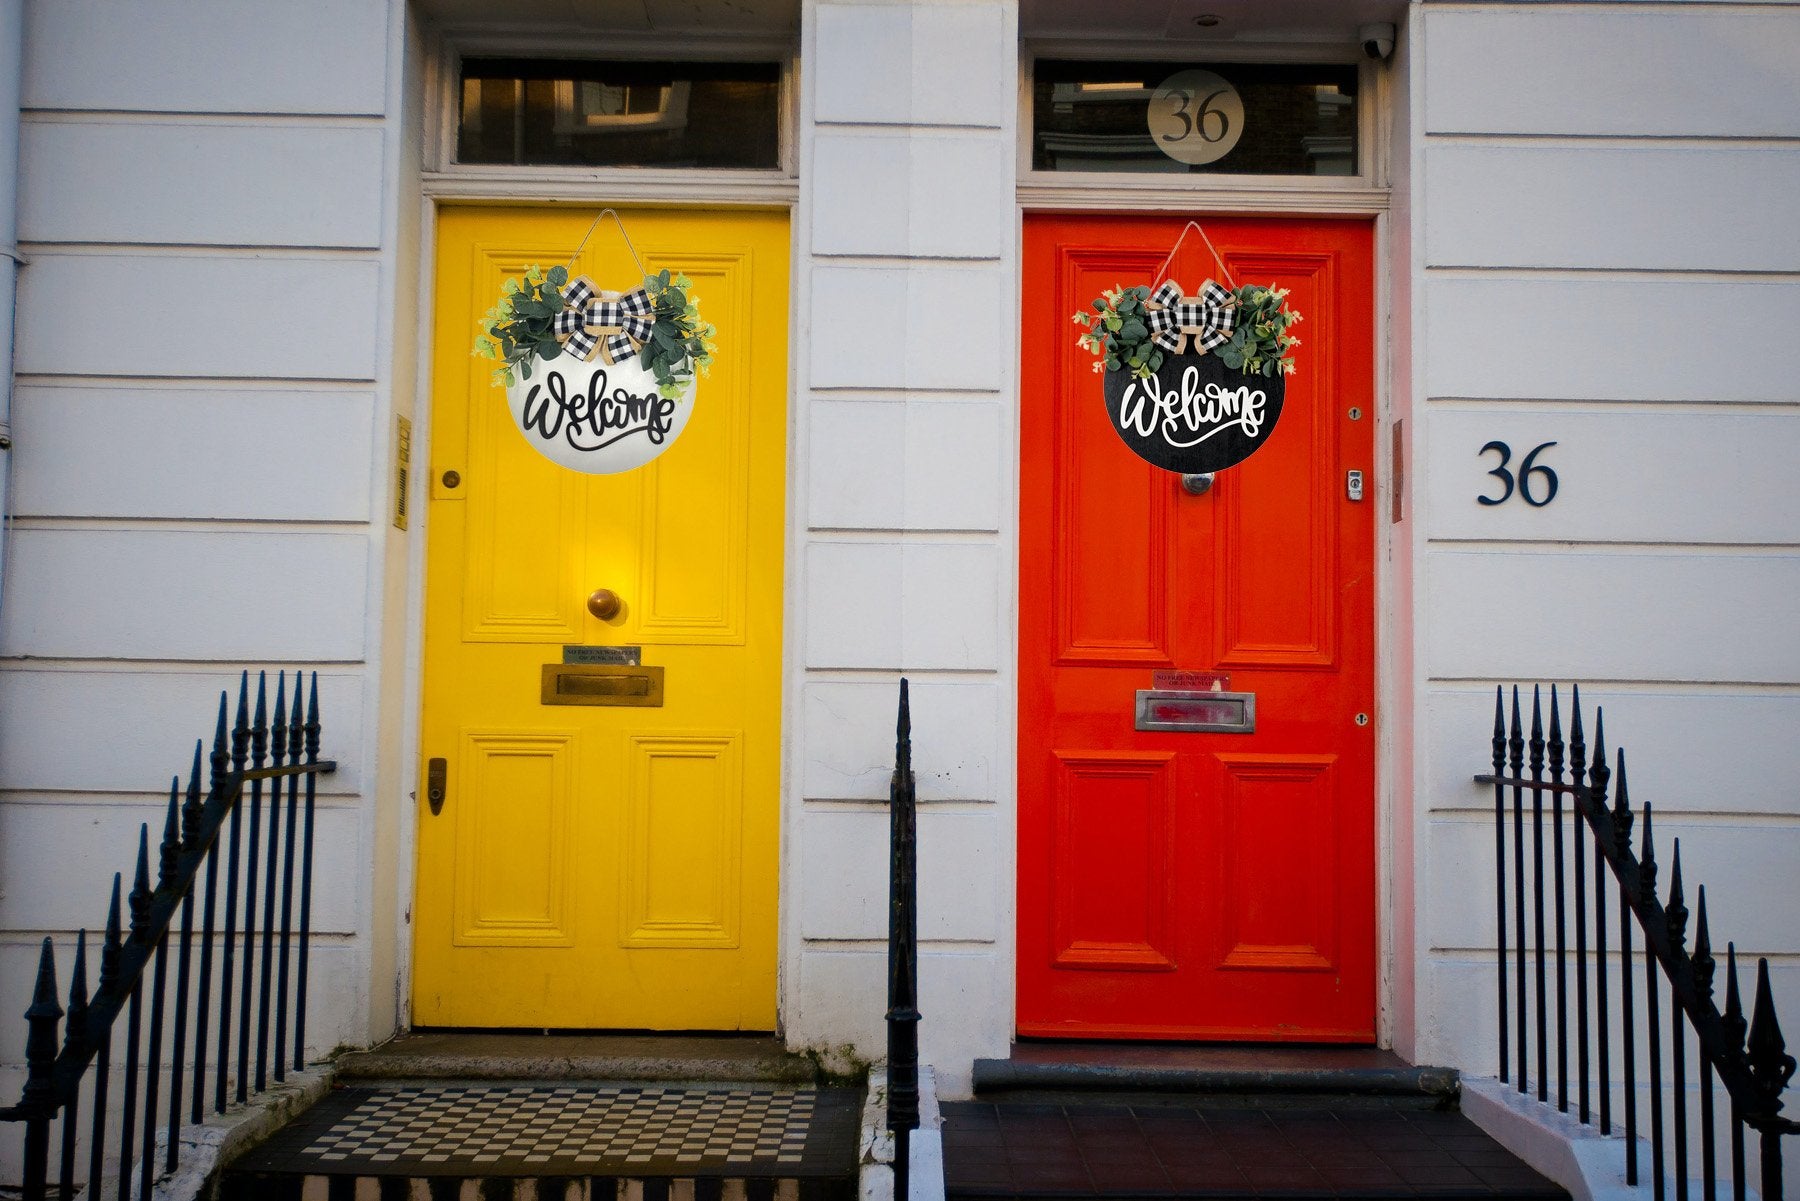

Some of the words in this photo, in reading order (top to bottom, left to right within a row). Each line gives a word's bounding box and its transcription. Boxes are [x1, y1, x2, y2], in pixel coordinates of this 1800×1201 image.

[1162, 88, 1229, 143] 36
[523, 369, 675, 452] Welcome
[1120, 365, 1266, 448] Welcome
[1477, 440, 1559, 507] 36
